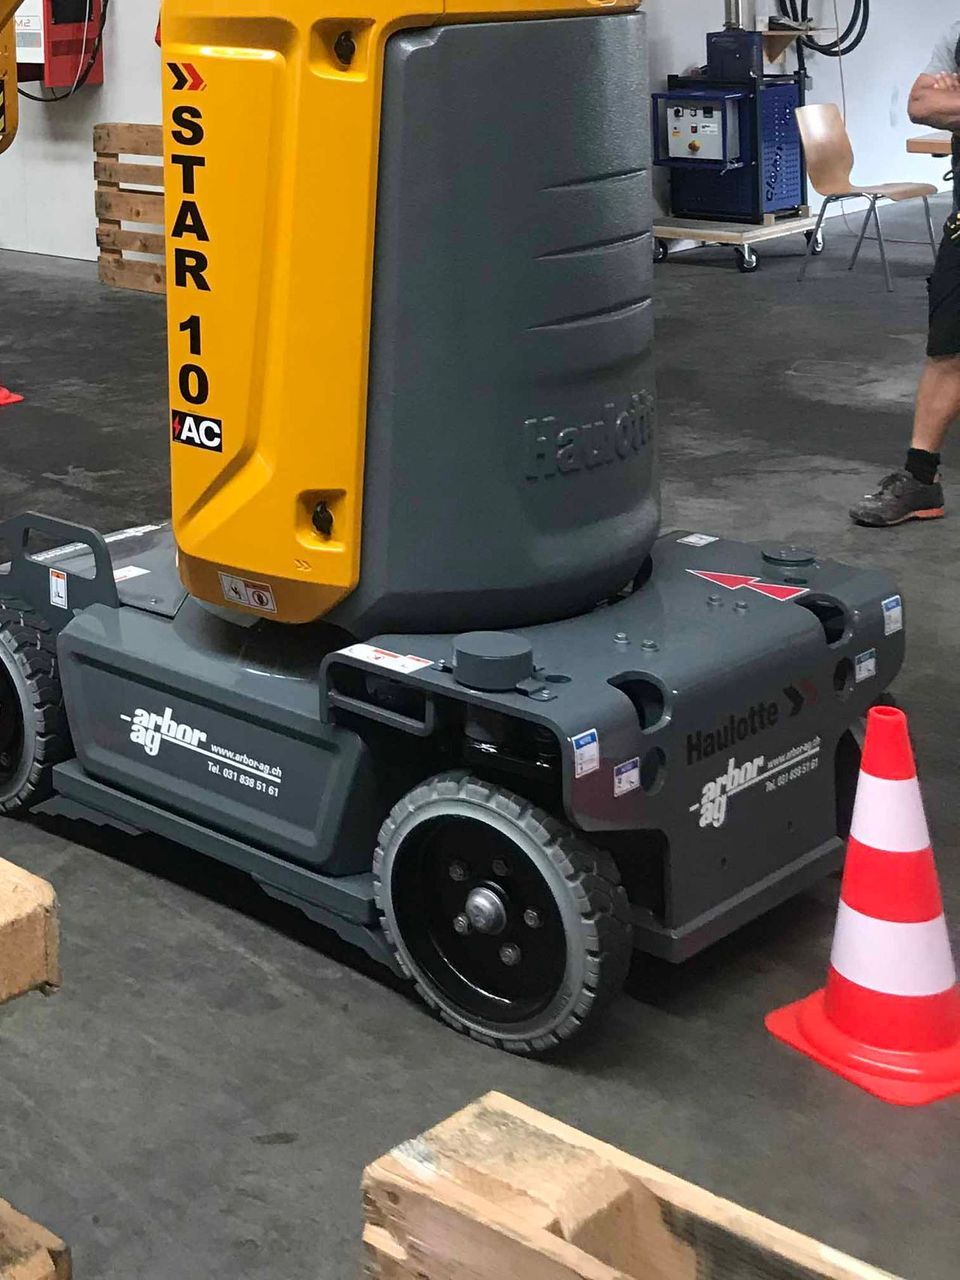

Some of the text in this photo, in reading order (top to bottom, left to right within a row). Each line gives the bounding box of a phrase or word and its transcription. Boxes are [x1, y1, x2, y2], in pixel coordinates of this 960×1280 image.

[171, 105, 212, 406] STAR 10
[180, 416, 221, 447] AC
[129, 723, 162, 757] ag
[132, 706, 208, 747] arbor
[686, 701, 780, 766] Haulotte
[207, 760, 280, 798] Tel. 031 838 51 61
[210, 743, 283, 778] www.arbor-ag.ch
[700, 755, 766, 806] arbor
[698, 794, 728, 828] ag
